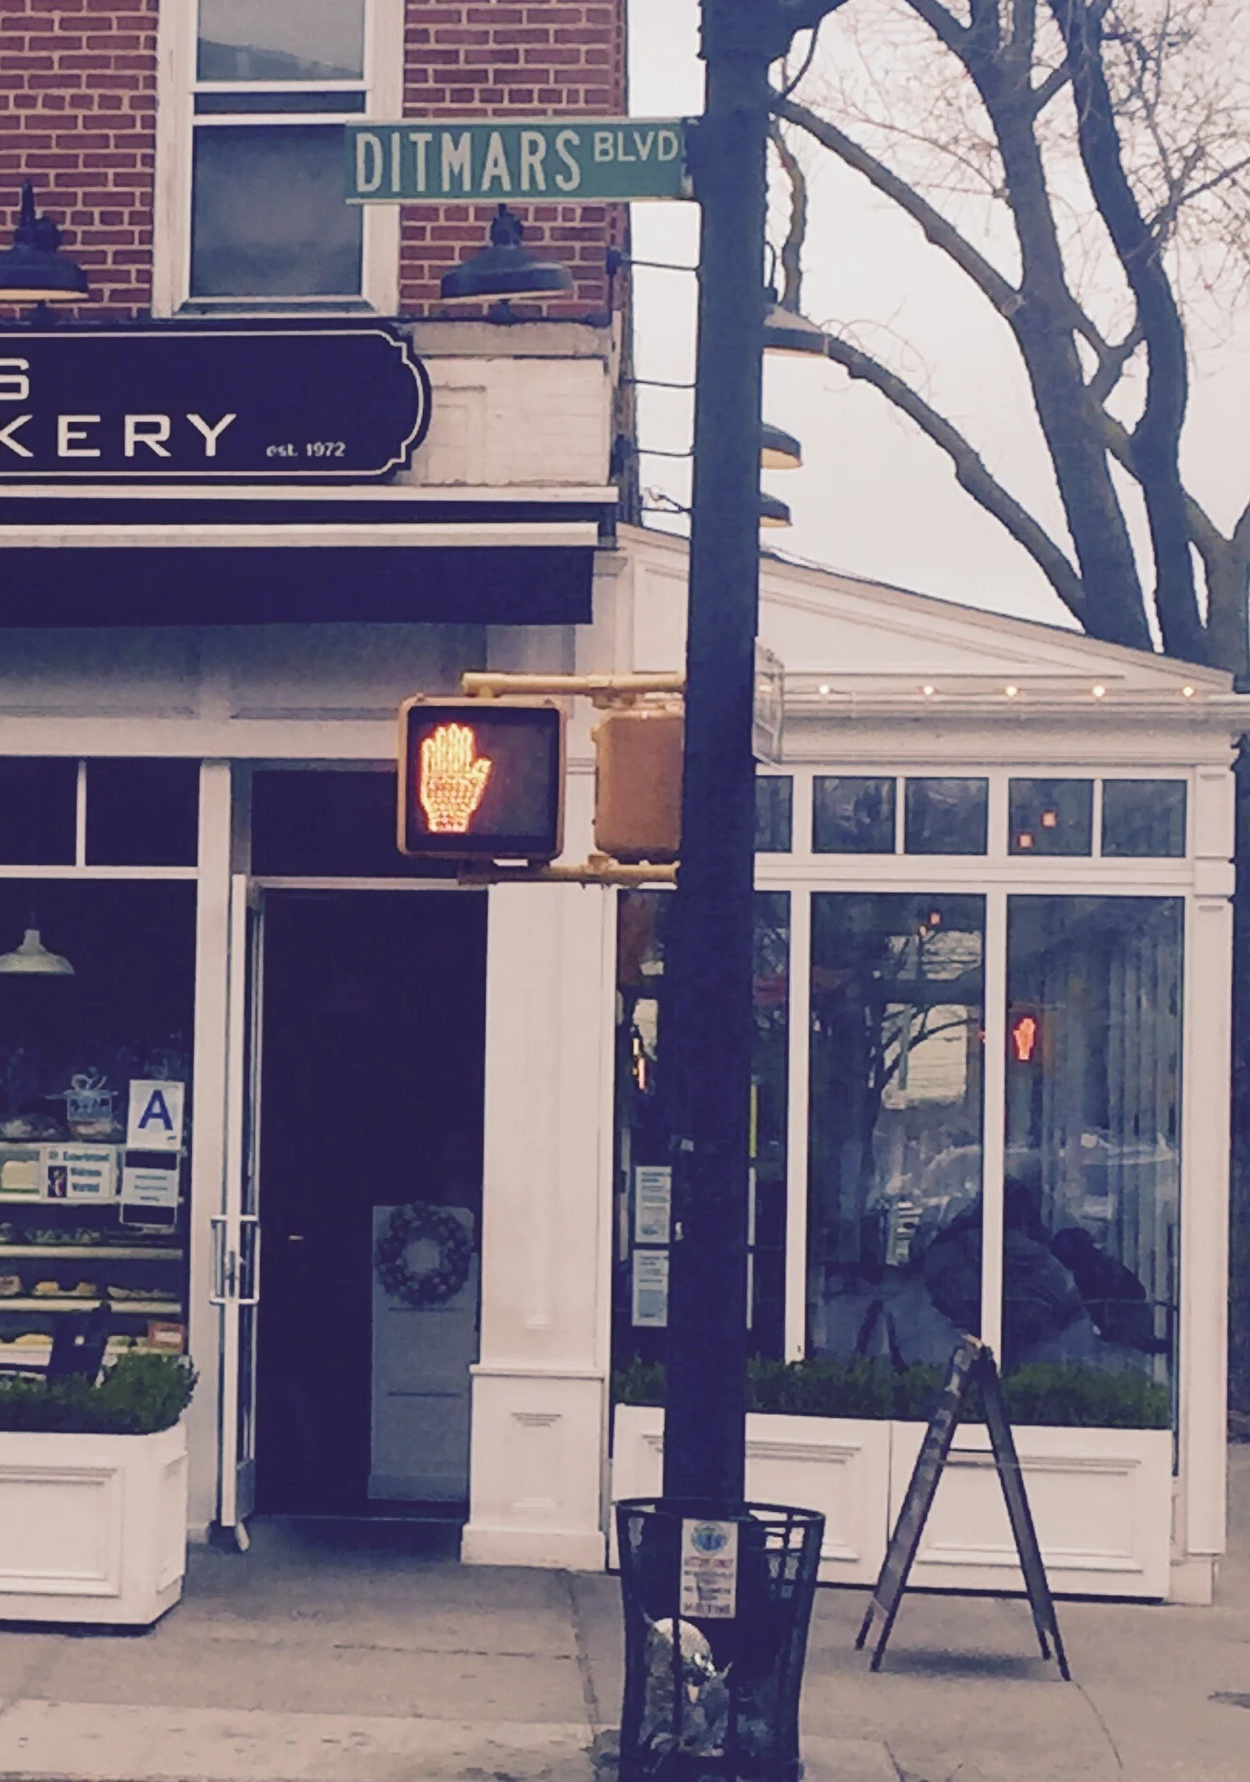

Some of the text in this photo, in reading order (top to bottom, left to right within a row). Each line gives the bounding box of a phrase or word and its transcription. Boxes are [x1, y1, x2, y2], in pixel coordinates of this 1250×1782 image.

[356, 129, 679, 193] DITMARS BLVD
[306, 441, 346, 457] 1972
[137, 1089, 174, 1131] A
